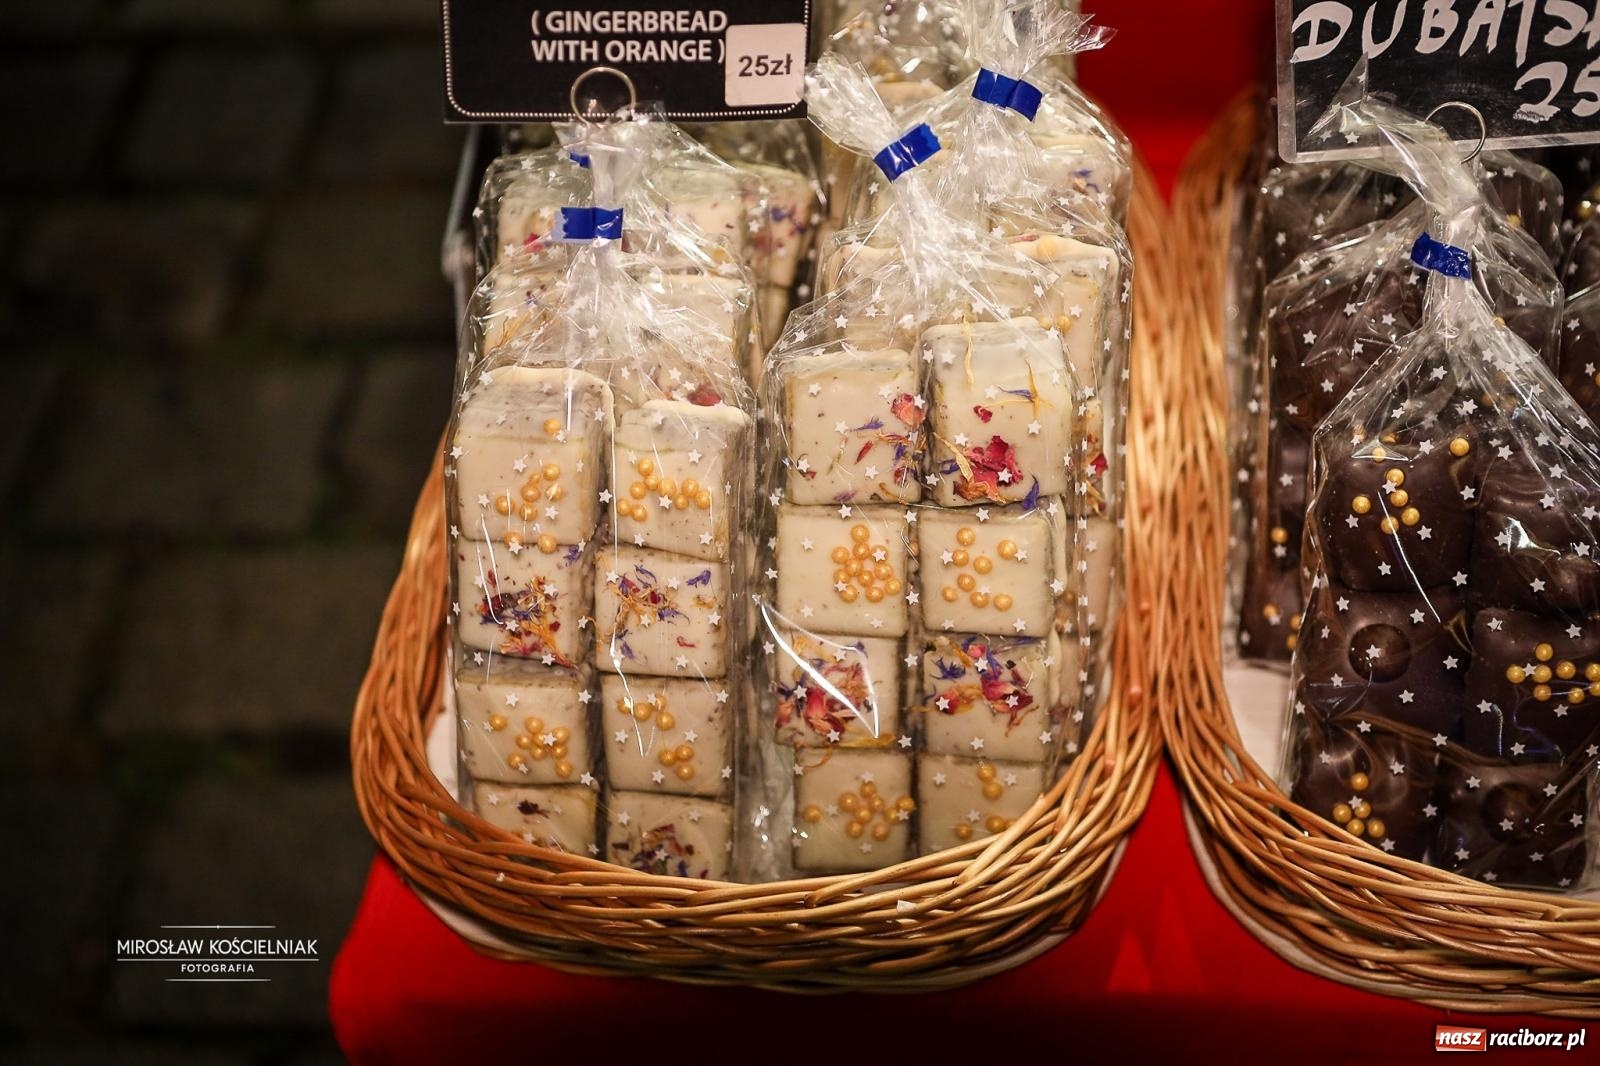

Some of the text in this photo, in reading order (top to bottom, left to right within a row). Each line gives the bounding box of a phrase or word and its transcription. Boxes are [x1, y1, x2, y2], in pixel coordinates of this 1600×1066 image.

[545, 9, 728, 33] GINGERBREAD
[531, 39, 599, 62] WITH
[605, 39, 712, 62] ORANGE
[738, 53, 793, 77] 25zł
